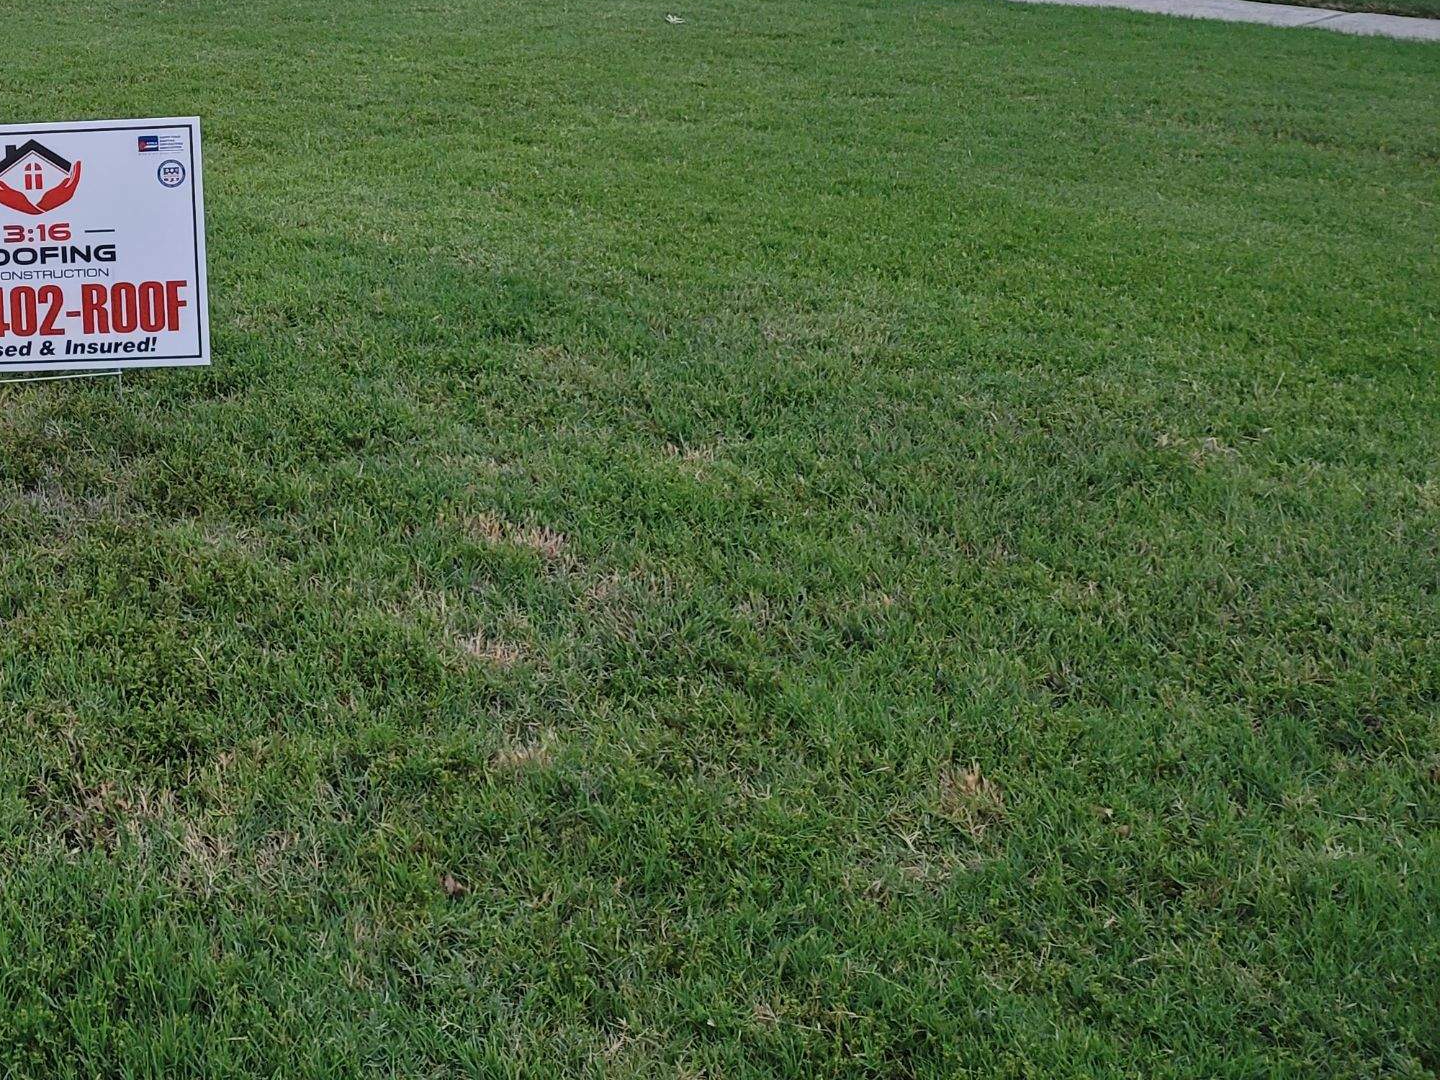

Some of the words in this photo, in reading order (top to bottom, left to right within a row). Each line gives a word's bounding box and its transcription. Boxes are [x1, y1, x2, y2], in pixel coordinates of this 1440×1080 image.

[3, 222, 72, 244] 3:16
[39, 340, 56, 355] &
[65, 336, 158, 355] Insured!
